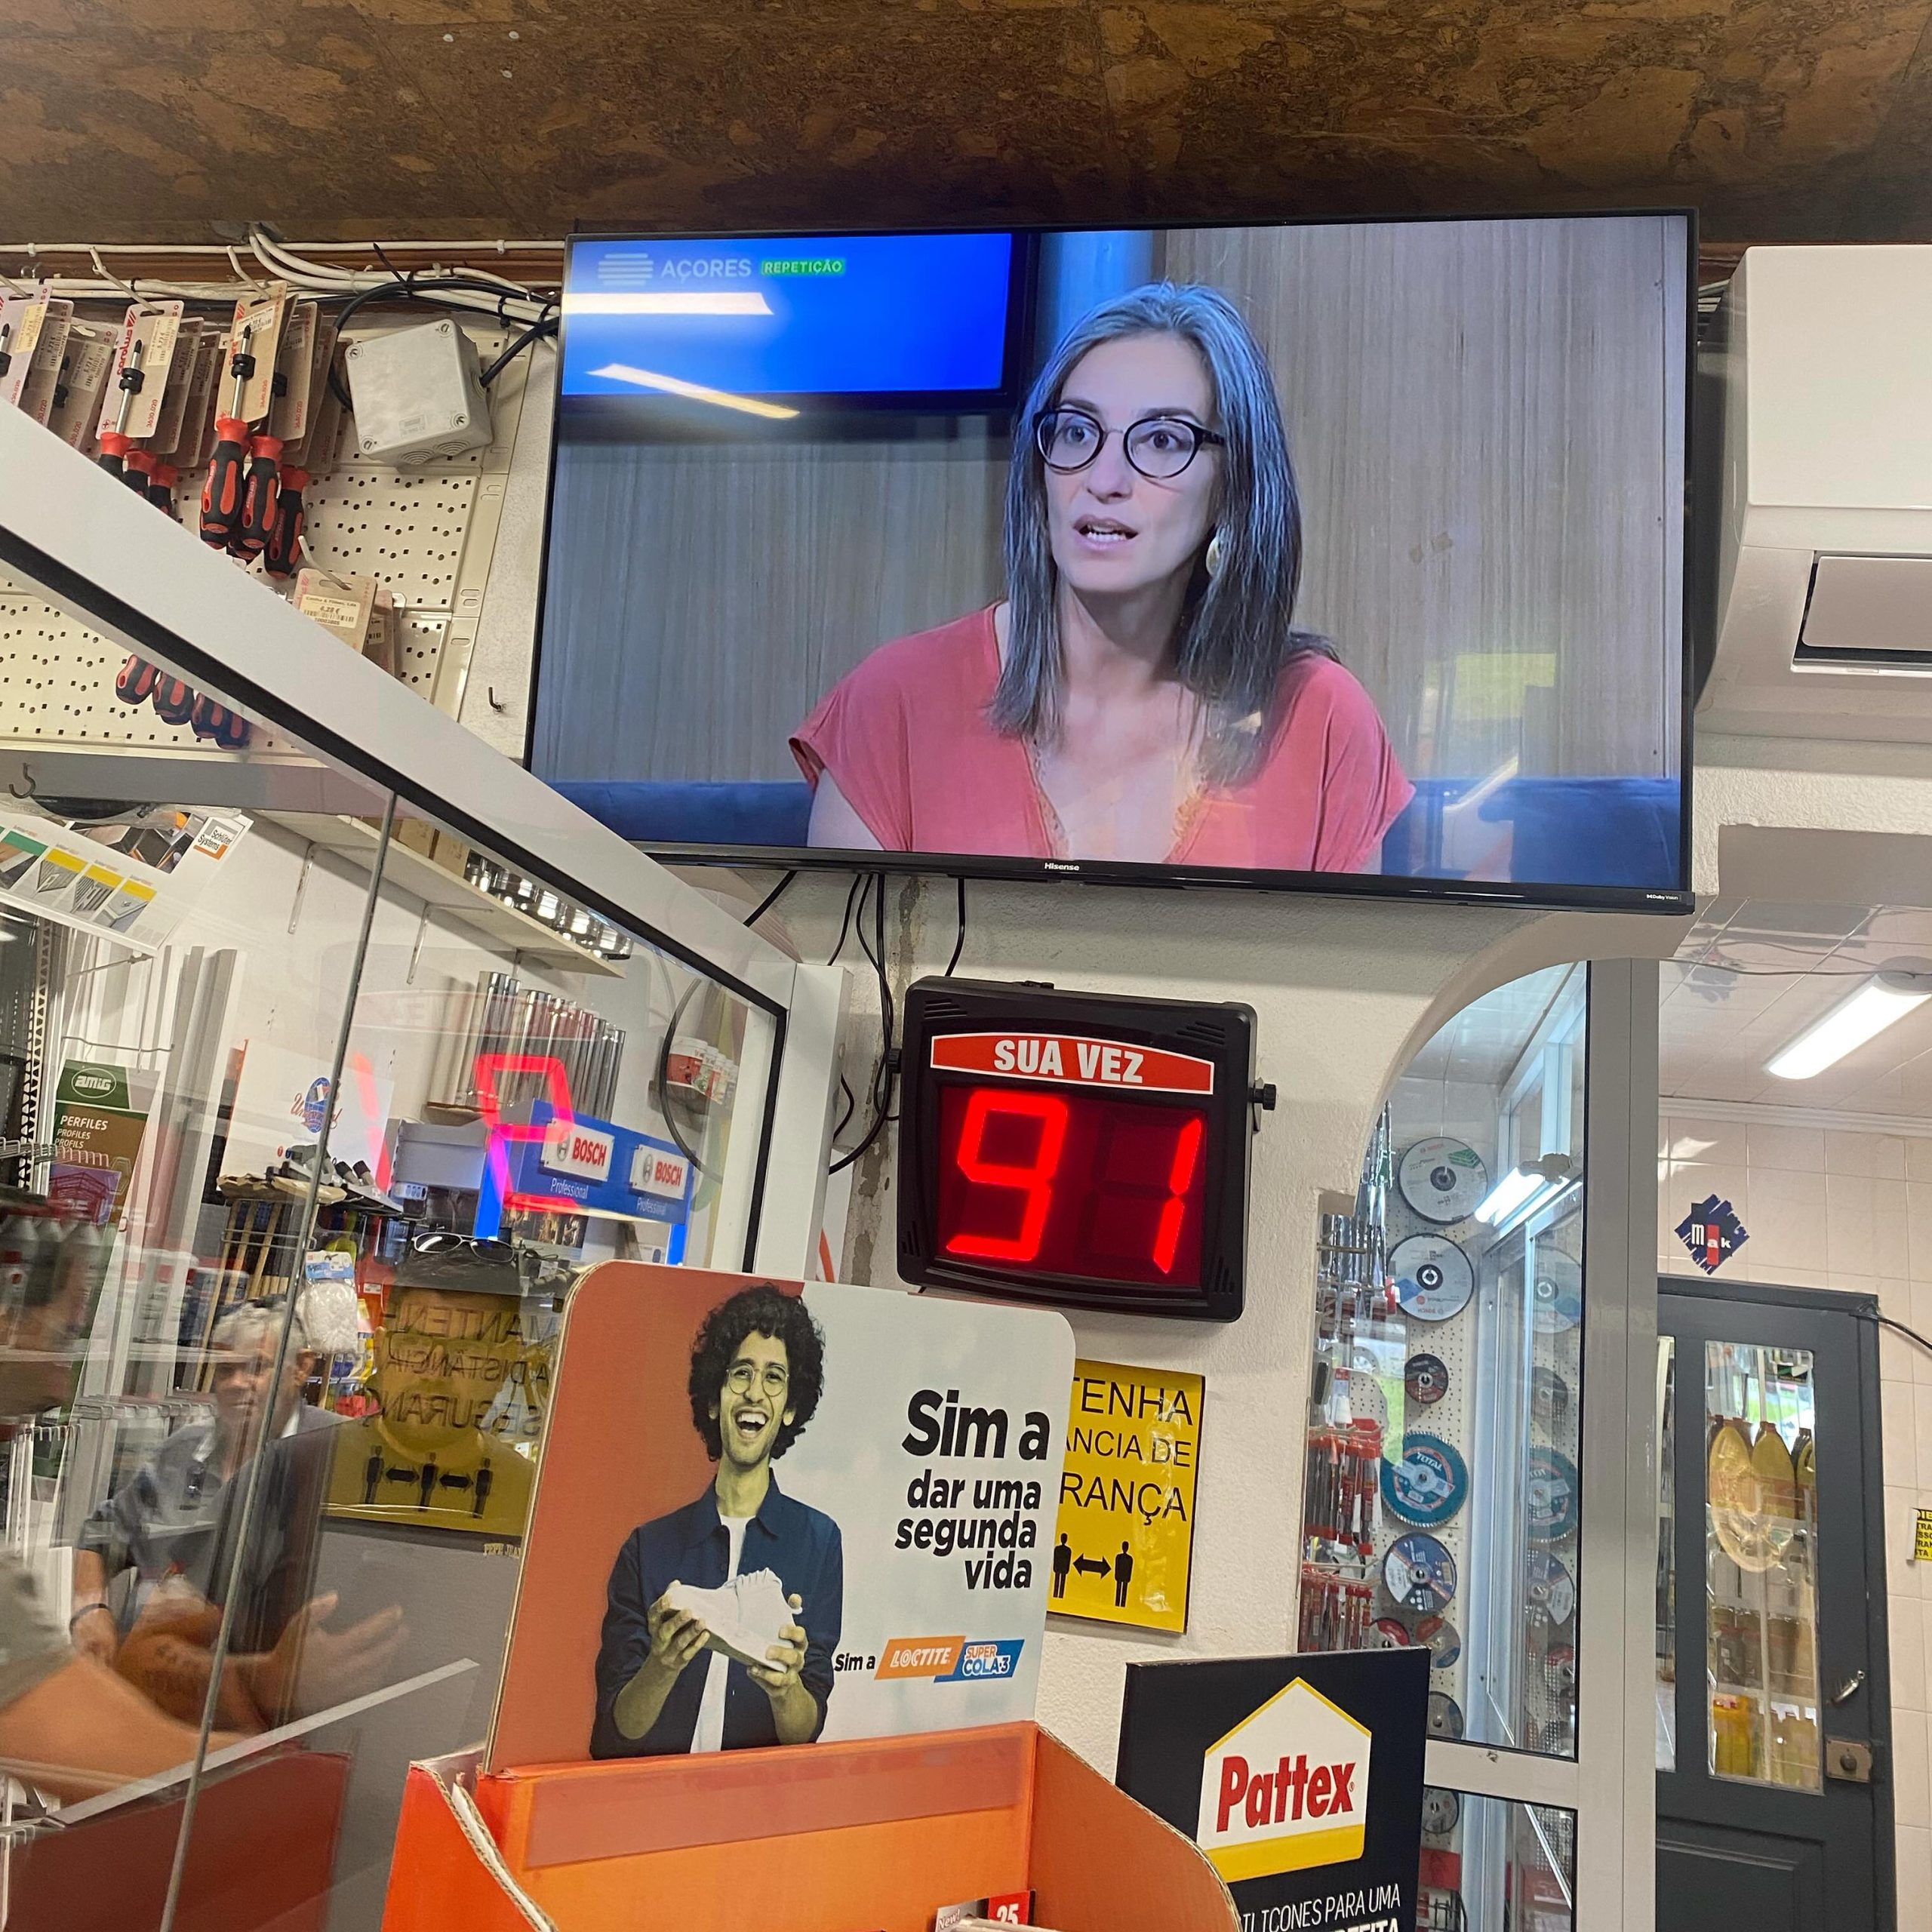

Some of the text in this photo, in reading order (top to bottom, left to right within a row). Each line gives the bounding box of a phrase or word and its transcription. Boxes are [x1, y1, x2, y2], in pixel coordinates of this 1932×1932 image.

[661, 259, 752, 281] AÇORES
[764, 259, 842, 275] REPETIÇÃO
[116, 330, 134, 375] carolus
[198, 834, 220, 851] Systems
[1044, 862, 1080, 871] Hisense
[994, 1039, 1144, 1084] SUA VEZ
[57, 1128, 91, 1140] PROFILES
[60, 1115, 109, 1131] PERFILES
[54, 1137, 85, 1149] PROFILS
[572, 1137, 608, 1167] BOSCH
[654, 1161, 683, 1187] BOSCH
[946, 1089, 1202, 1274] 91
[550, 1177, 589, 1200] Professional
[636, 1196, 666, 1216] Professional
[901, 1389, 1051, 1461] Sim a
[1152, 1436, 1192, 1469] DE
[1417, 1451, 1444, 1472] TOTAL
[907, 1468, 1042, 1511] dar uma
[894, 1511, 1037, 1557] segunda
[964, 1550, 1033, 1590] vida
[833, 1653, 876, 1672] Sim a
[890, 1646, 952, 1668] LOCTITE
[965, 1645, 997, 1660] SUPER
[1216, 1753, 1356, 1833] Pattex
[1325, 1890, 1366, 1924] PARA
[1368, 1883, 1401, 1913] UMA
[938, 1909, 961, 1930] New!
